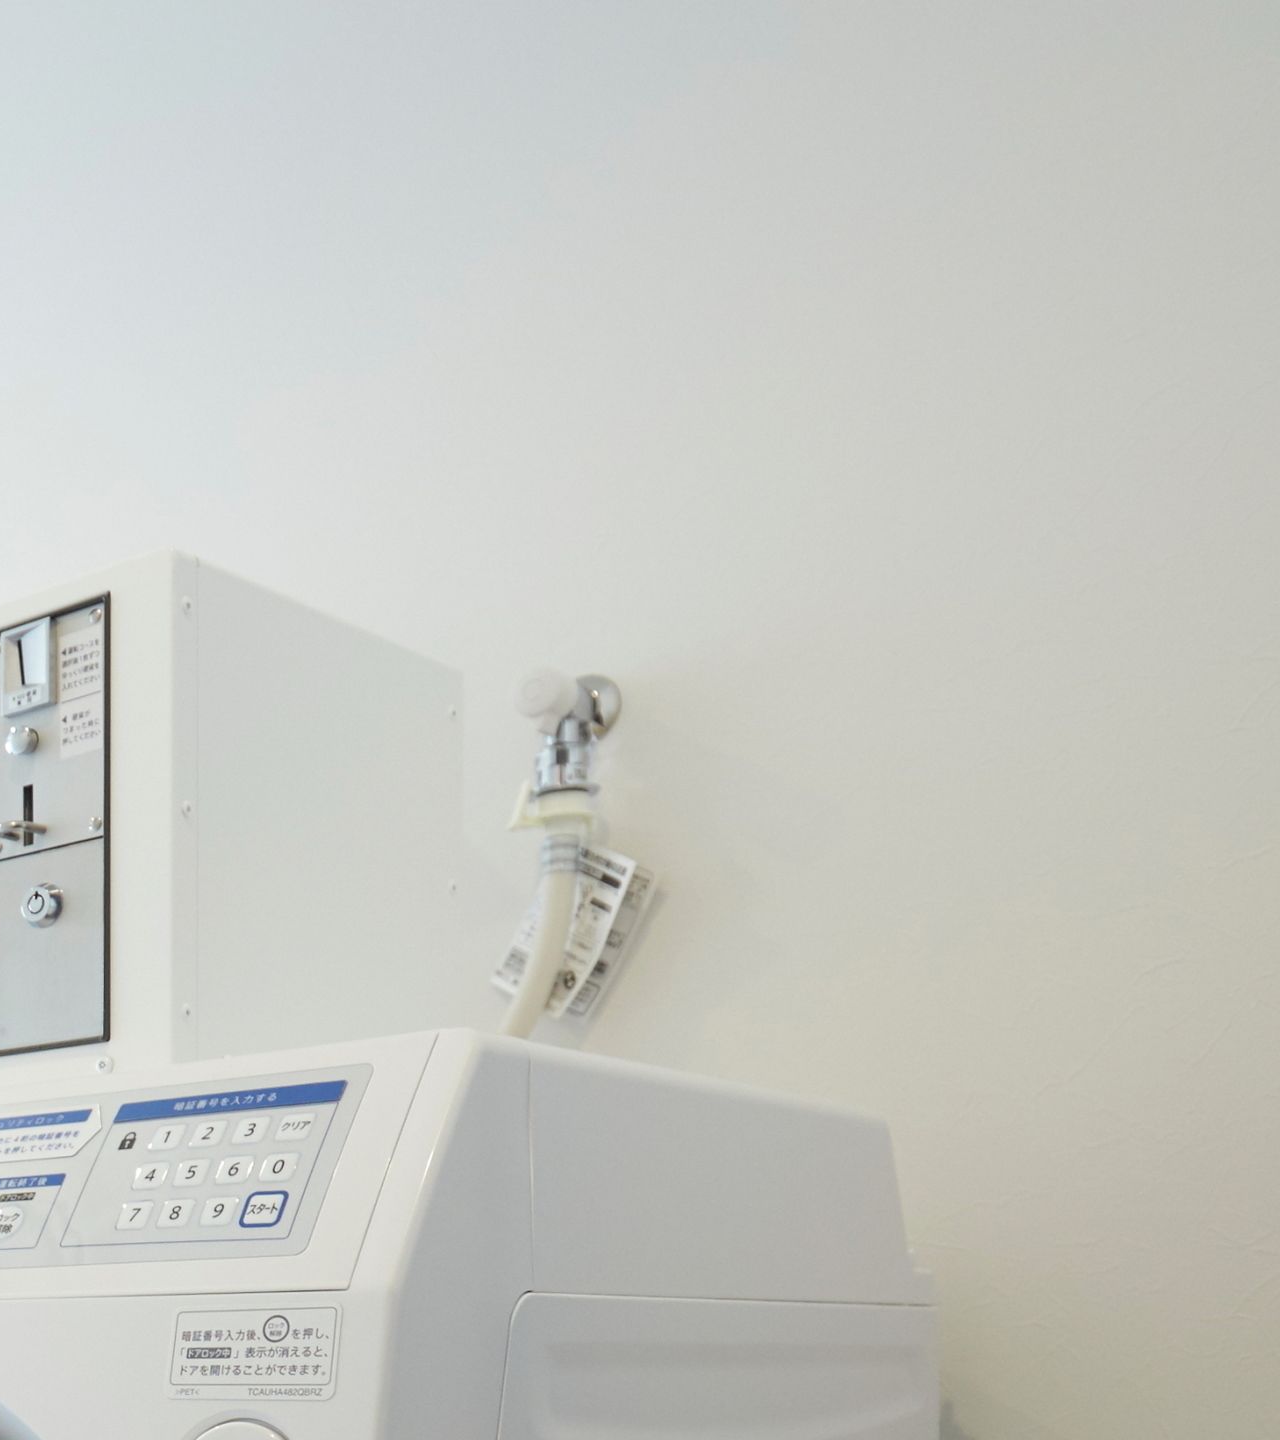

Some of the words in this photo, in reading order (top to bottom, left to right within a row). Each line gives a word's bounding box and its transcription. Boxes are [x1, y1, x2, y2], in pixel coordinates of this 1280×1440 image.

[173, 1092, 278, 1111] 暗証番号を入力する
[163, 1130, 172, 1143] 1
[201, 1126, 214, 1140] 2
[244, 1122, 257, 1137] 3
[281, 1119, 311, 1132] クリア
[145, 1168, 157, 1182] 4
[185, 1165, 198, 1179] 5
[228, 1161, 240, 1176] 6
[272, 1159, 285, 1174] 0
[129, 1207, 142, 1222] 7
[169, 1205, 181, 1220] 8
[213, 1203, 225, 1218] 9
[246, 1202, 278, 1215] スタート
[181, 1329, 262, 1342] 暗証番号入力後、
[291, 1328, 330, 1341] を押し、
[179, 1364, 326, 1377] ドアを開けることができます。
